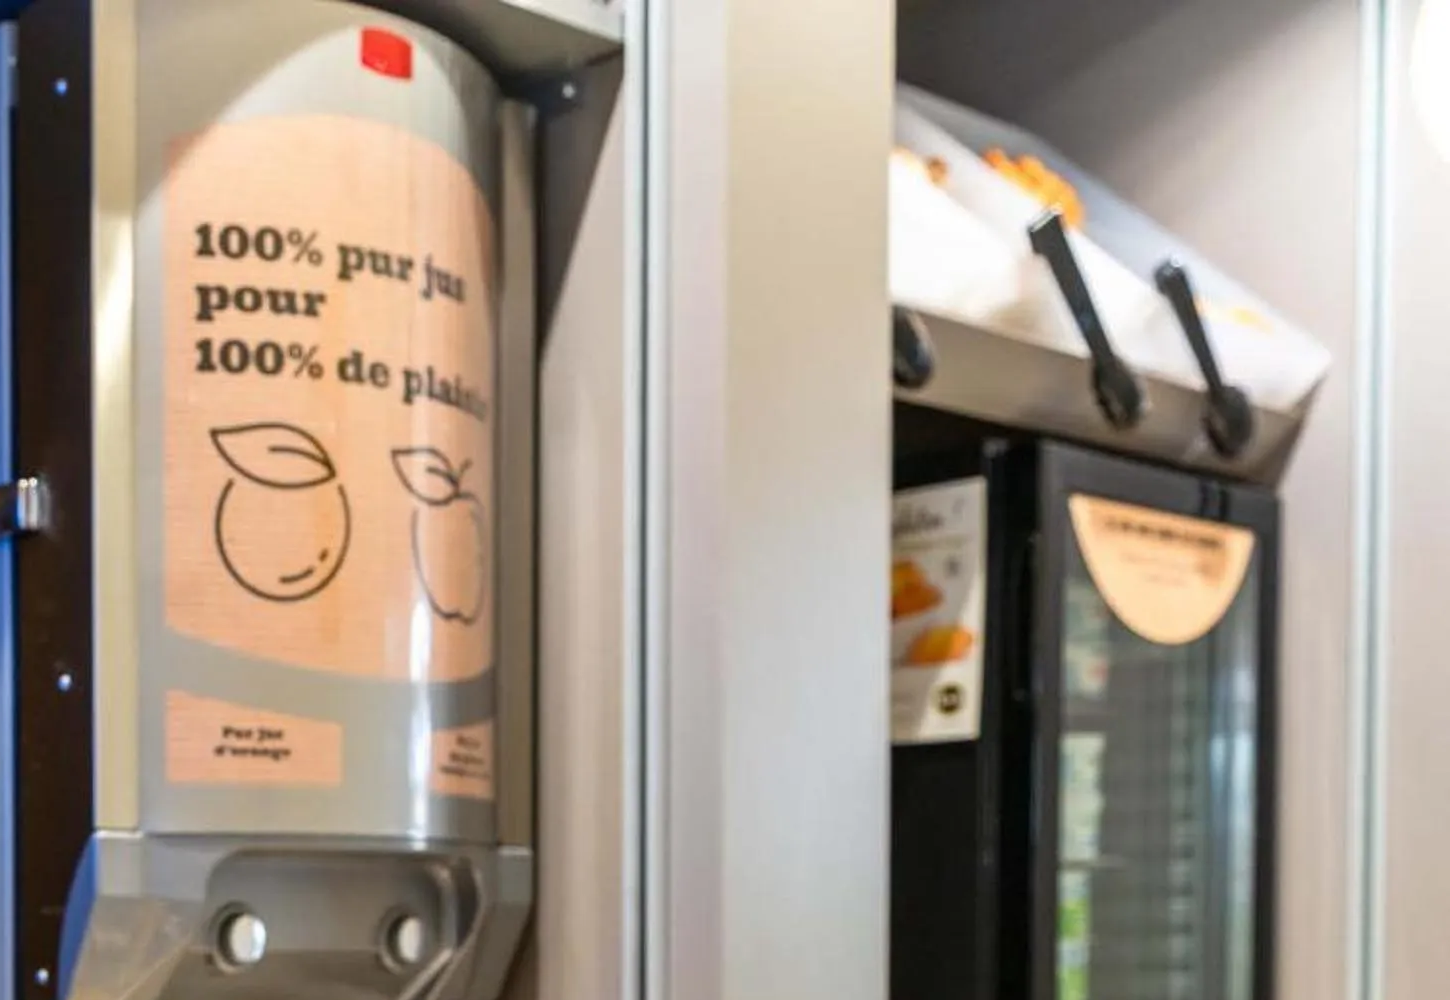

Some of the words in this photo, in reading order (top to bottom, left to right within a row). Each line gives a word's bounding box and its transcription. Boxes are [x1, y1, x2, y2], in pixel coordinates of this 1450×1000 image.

[195, 222, 323, 267] 100%
[336, 243, 415, 281] pur
[420, 253, 466, 303] jus
[195, 283, 327, 322] pour
[195, 337, 324, 379] 100%
[337, 350, 390, 388] de
